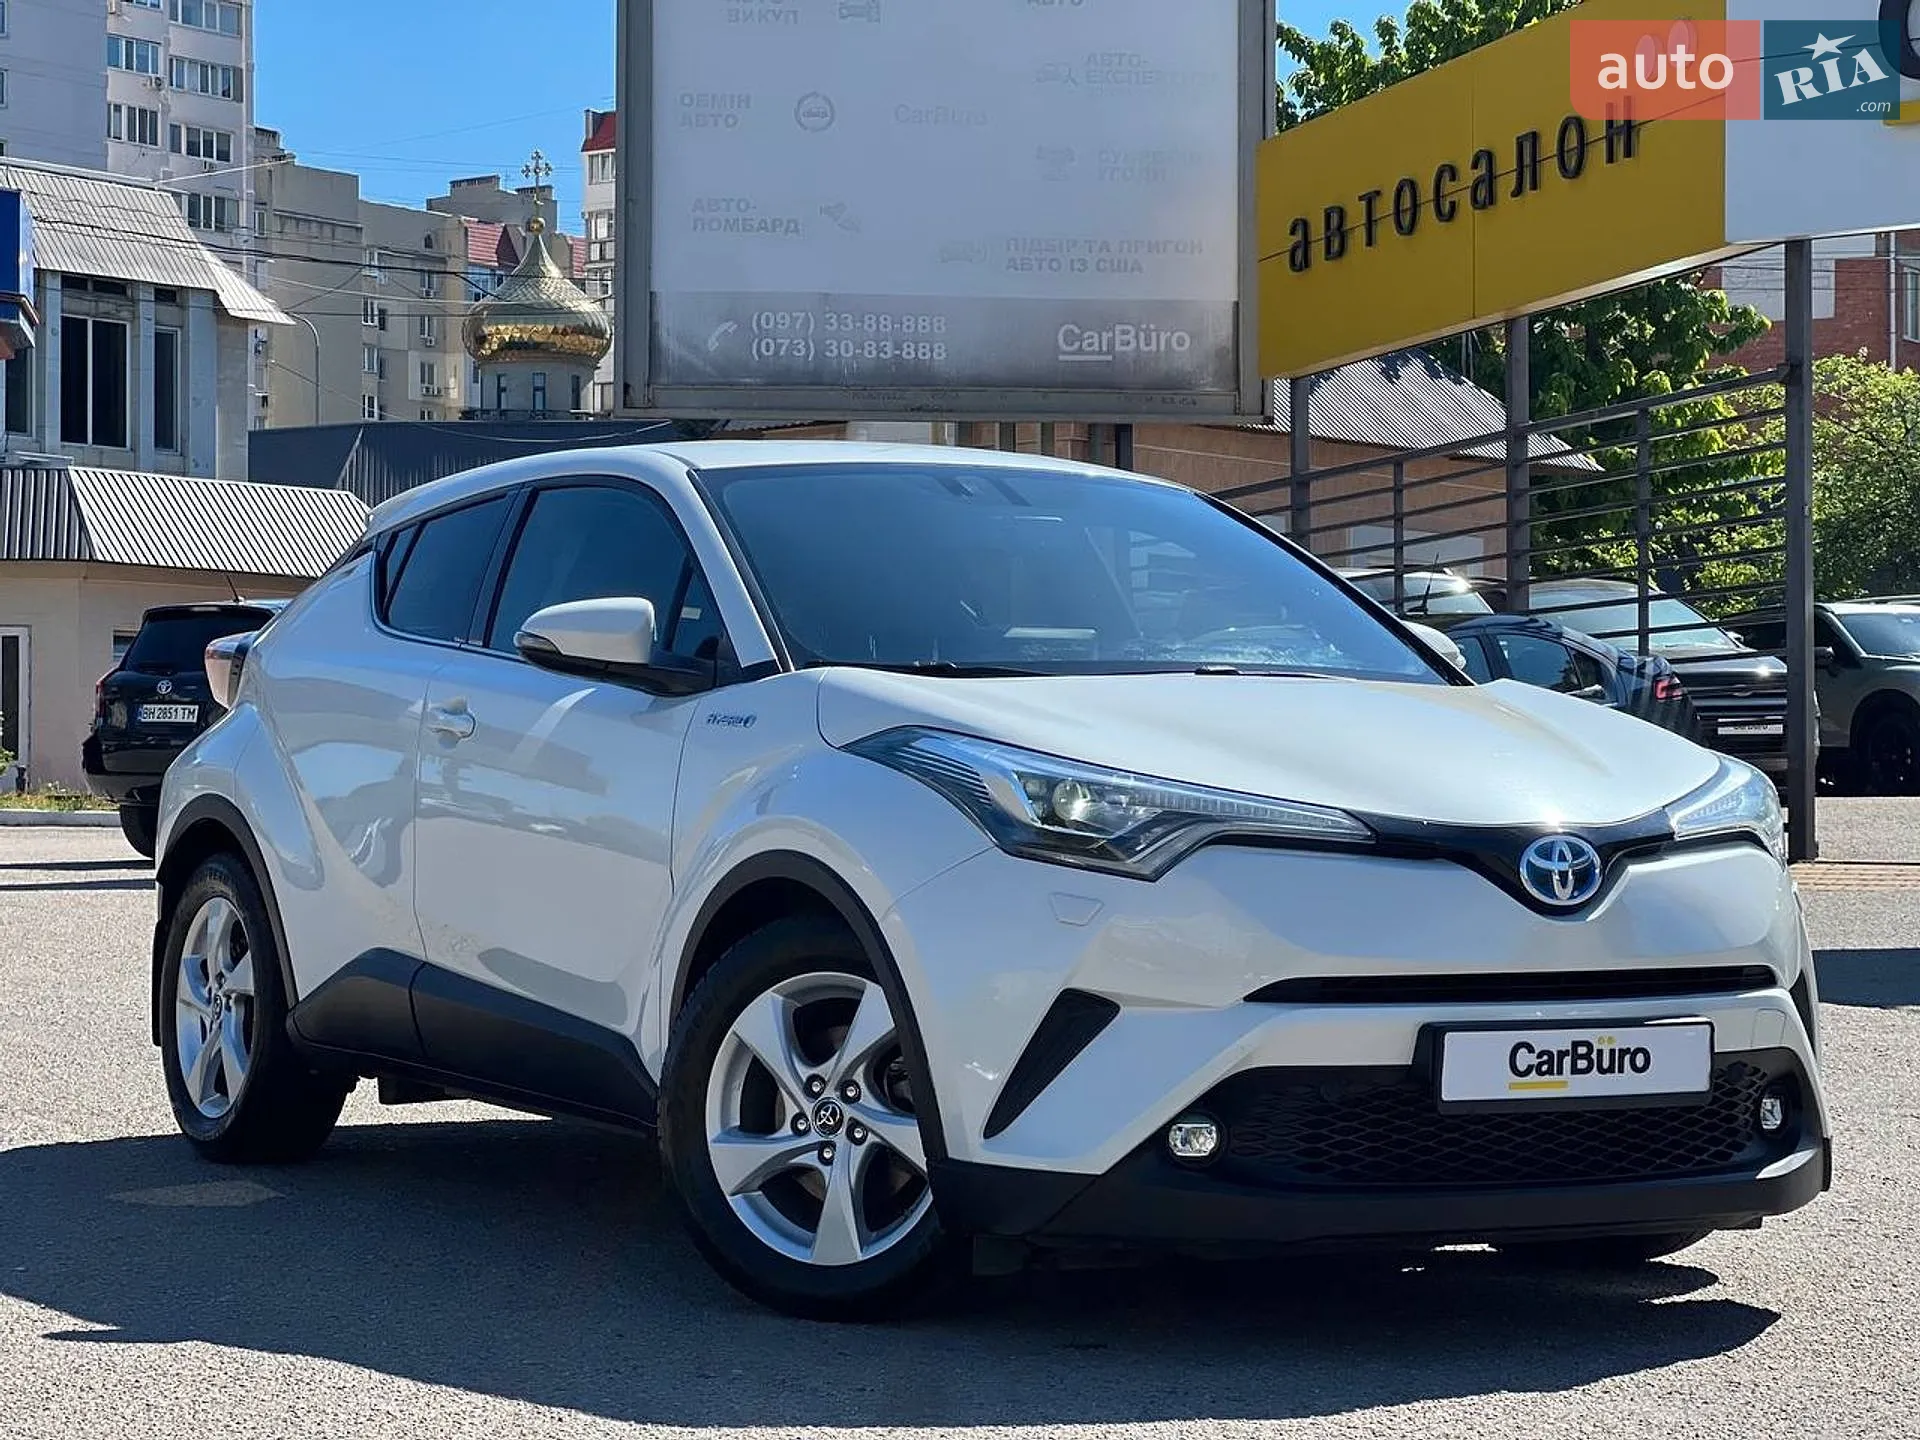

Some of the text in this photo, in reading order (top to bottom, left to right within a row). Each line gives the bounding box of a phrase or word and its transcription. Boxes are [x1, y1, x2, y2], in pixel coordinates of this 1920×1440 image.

[680, 92, 751, 109] ОБМІН
[679, 113, 739, 129] АВТО
[1288, 95, 1641, 272] автосалон
[691, 197, 757, 213] АВТО-
[1083, 240, 1112, 253] ТА
[1118, 239, 1204, 254] ПРИГОН
[1006, 257, 1145, 273] АВТО ІЗ США
[751, 311, 947, 336] (097) 33-88-888
[1057, 322, 1192, 352] CarBüro
[751, 337, 947, 361] (073) 30-83-888
[1508, 1035, 1651, 1078] CarBüro
